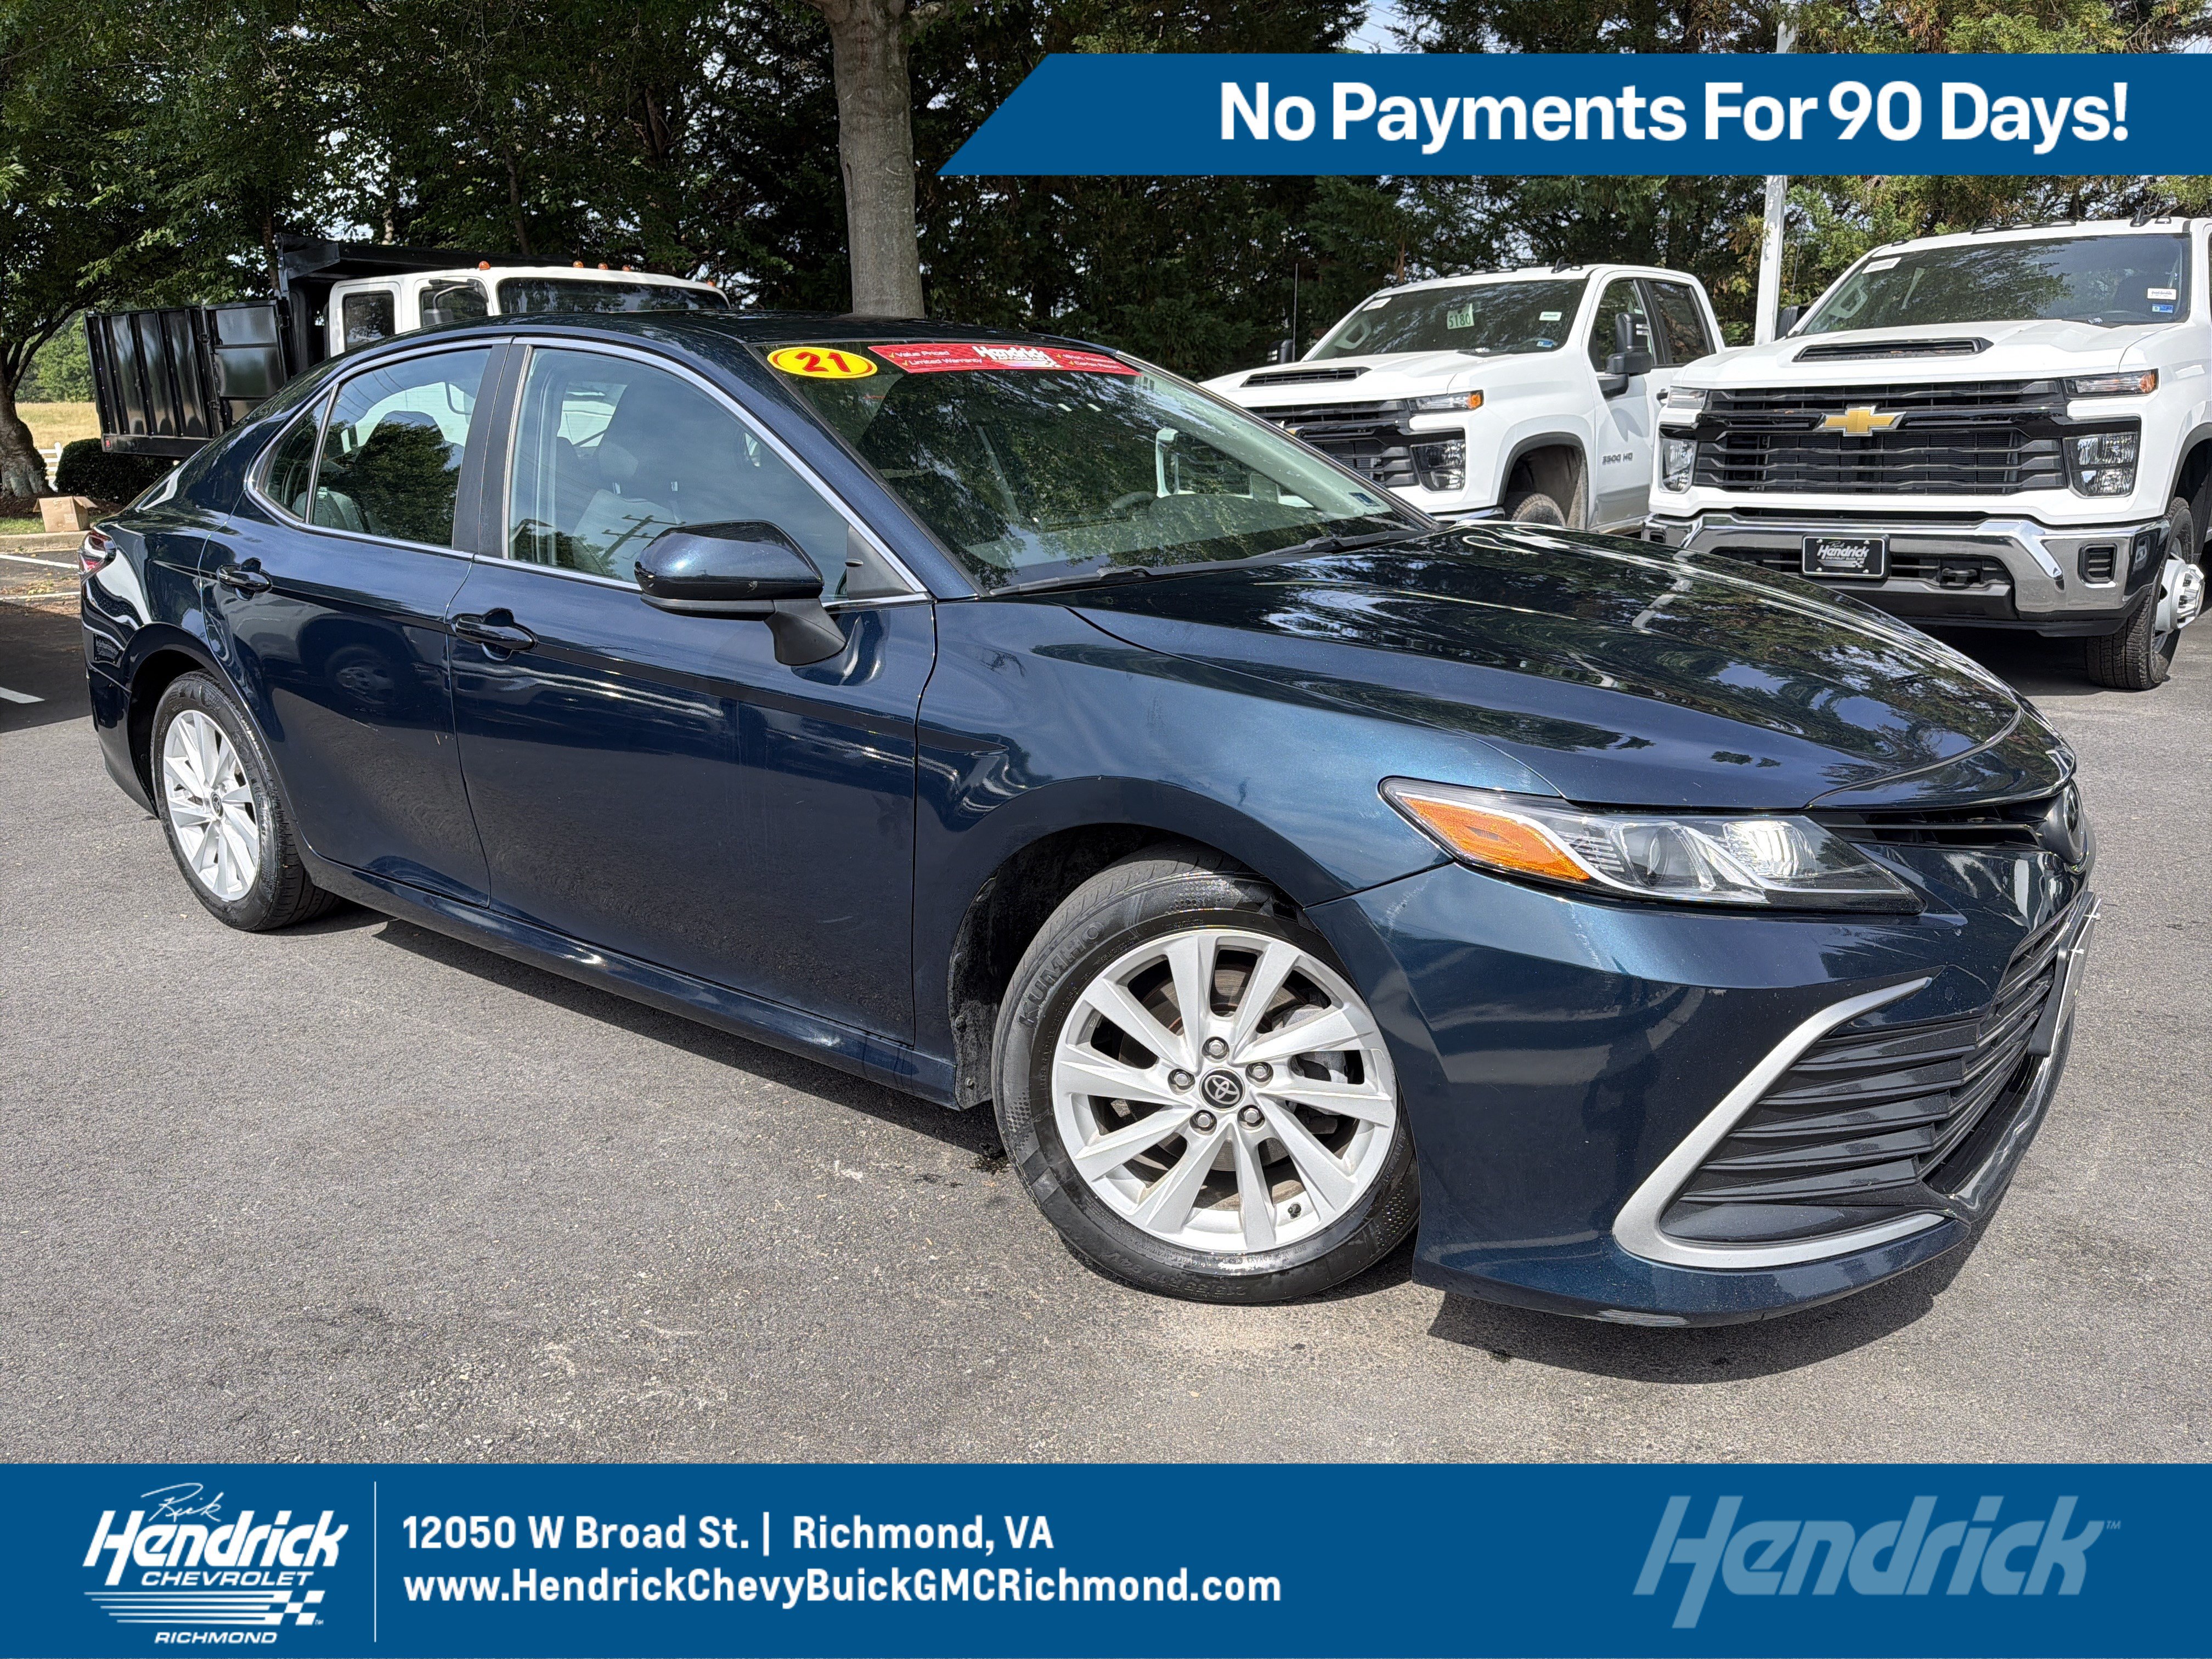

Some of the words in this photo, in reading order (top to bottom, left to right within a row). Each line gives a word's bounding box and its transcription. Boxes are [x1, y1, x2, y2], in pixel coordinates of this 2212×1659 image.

[1448, 313, 1472, 328] 5180
[794, 351, 852, 373] 21
[1816, 544, 1870, 560] Hendrick
[1019, 922, 1104, 1028] KUMHO
